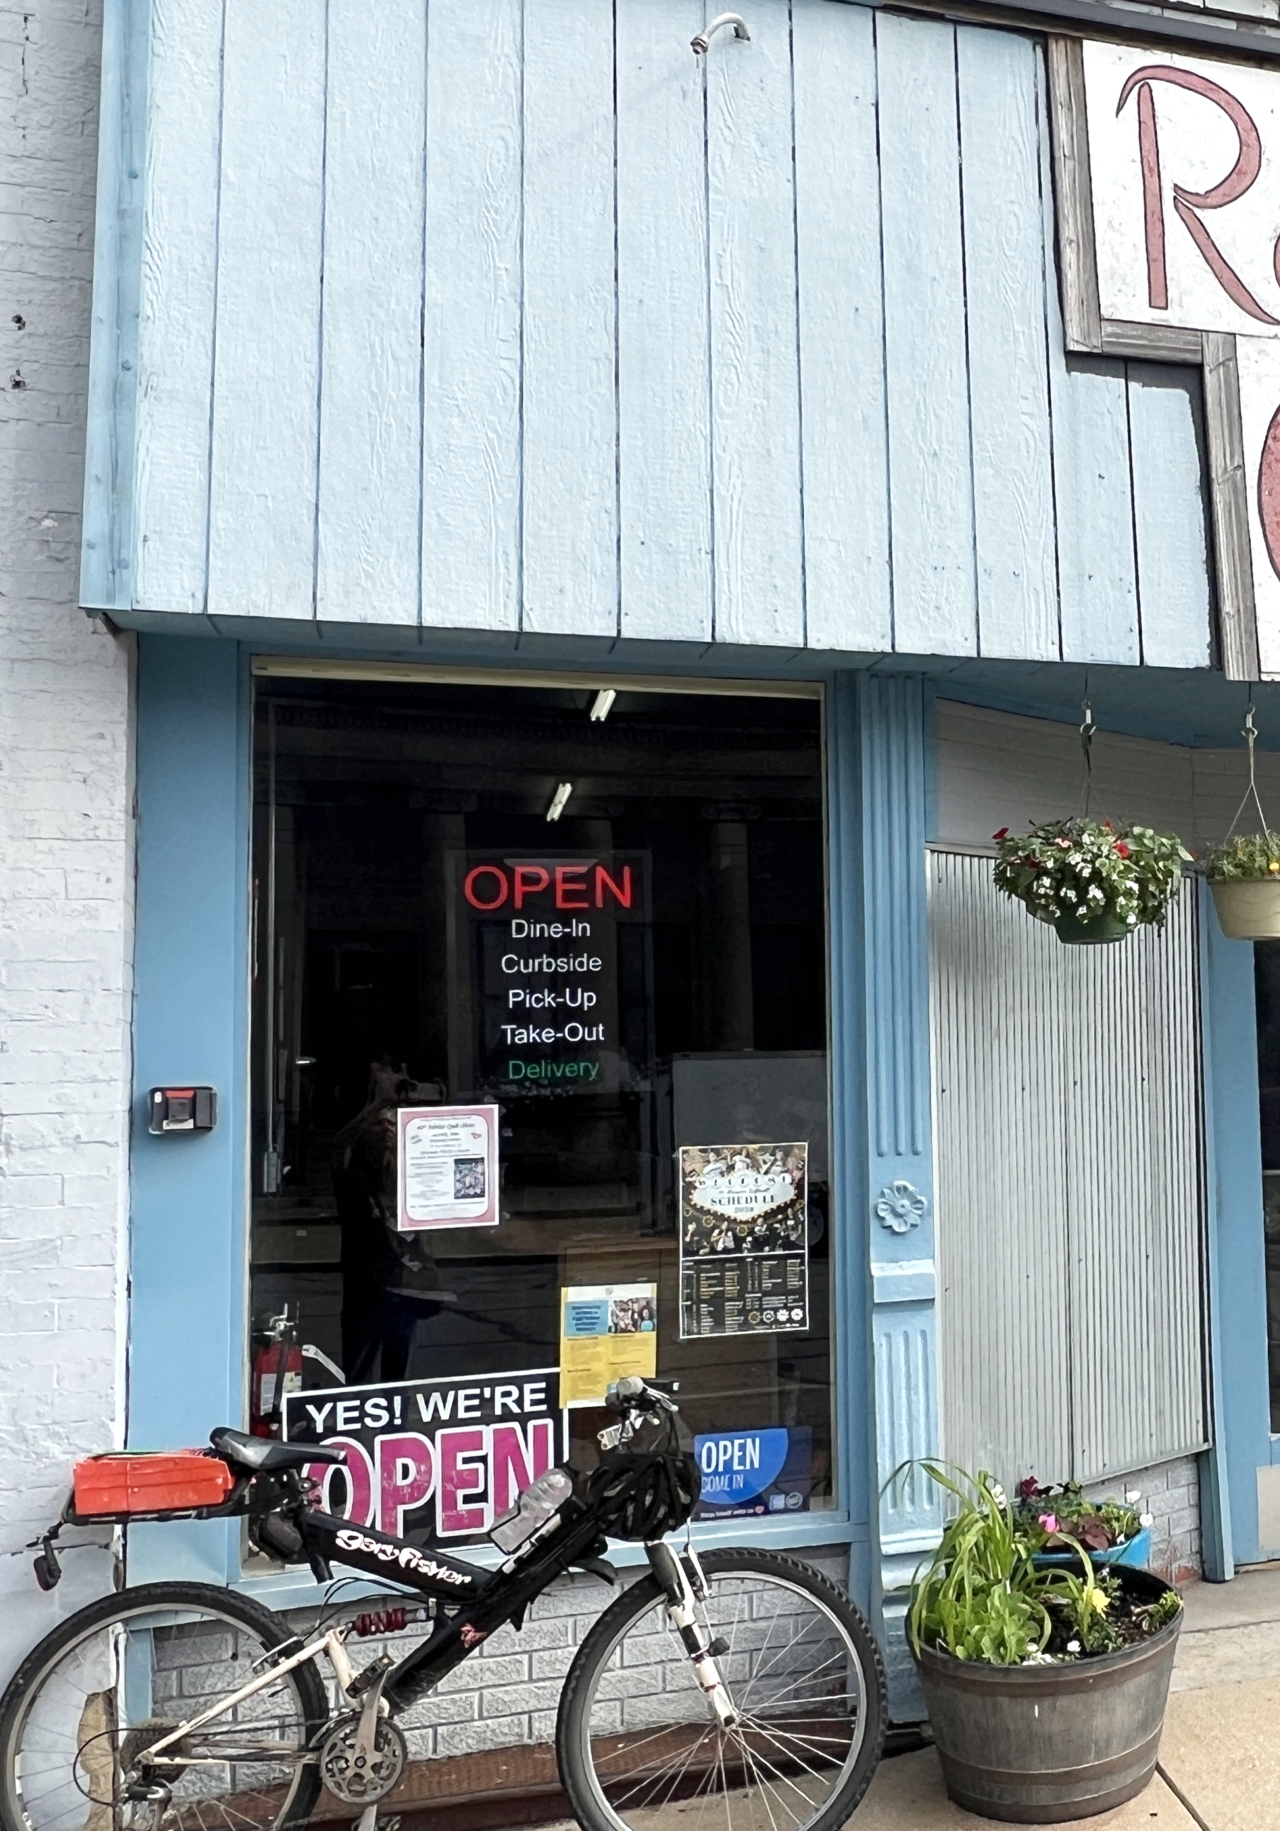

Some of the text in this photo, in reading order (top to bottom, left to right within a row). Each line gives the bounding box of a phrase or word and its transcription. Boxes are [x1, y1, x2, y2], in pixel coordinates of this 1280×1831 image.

[464, 865, 632, 910] OPEN
[511, 918, 591, 938] Dine-In
[501, 953, 602, 974] Curbside
[508, 987, 597, 1011] Pick-Up
[501, 1022, 605, 1045] Take-Out
[508, 1059, 599, 1081] Delivery
[710, 1194, 777, 1206] SCHEDULE
[306, 1381, 547, 1433] YES! WE'RE
[701, 1437, 760, 1473] OPEN
[301, 1418, 554, 1539] OPEN
[732, 1473, 744, 1490] IN
